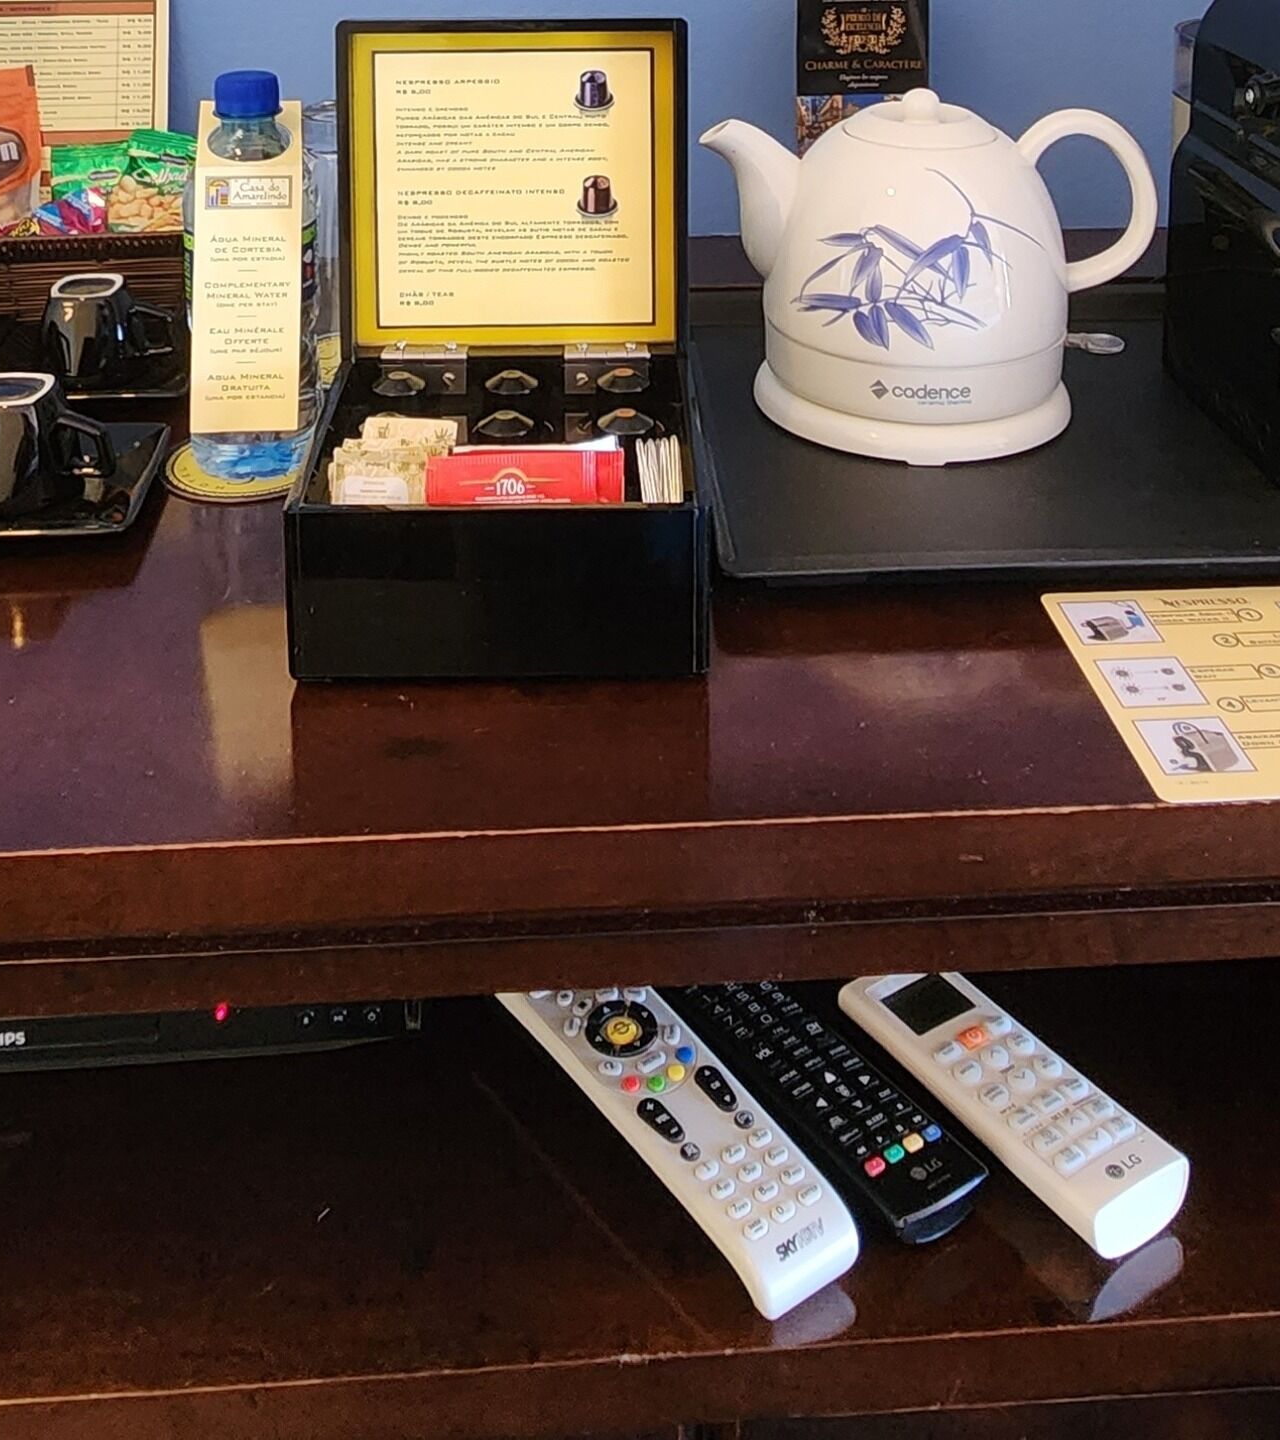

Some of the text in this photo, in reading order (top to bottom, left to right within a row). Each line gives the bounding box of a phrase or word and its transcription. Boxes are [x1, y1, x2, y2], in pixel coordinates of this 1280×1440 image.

[240, 182, 280, 192] Casa do
[204, 281, 291, 289] COMPLEMENTARY
[891, 384, 971, 400] cadence
[496, 478, 525, 496] 1706
[924, 1158, 943, 1173] LG
[1121, 1153, 1142, 1170] LG
[775, 1232, 799, 1262] SKY
